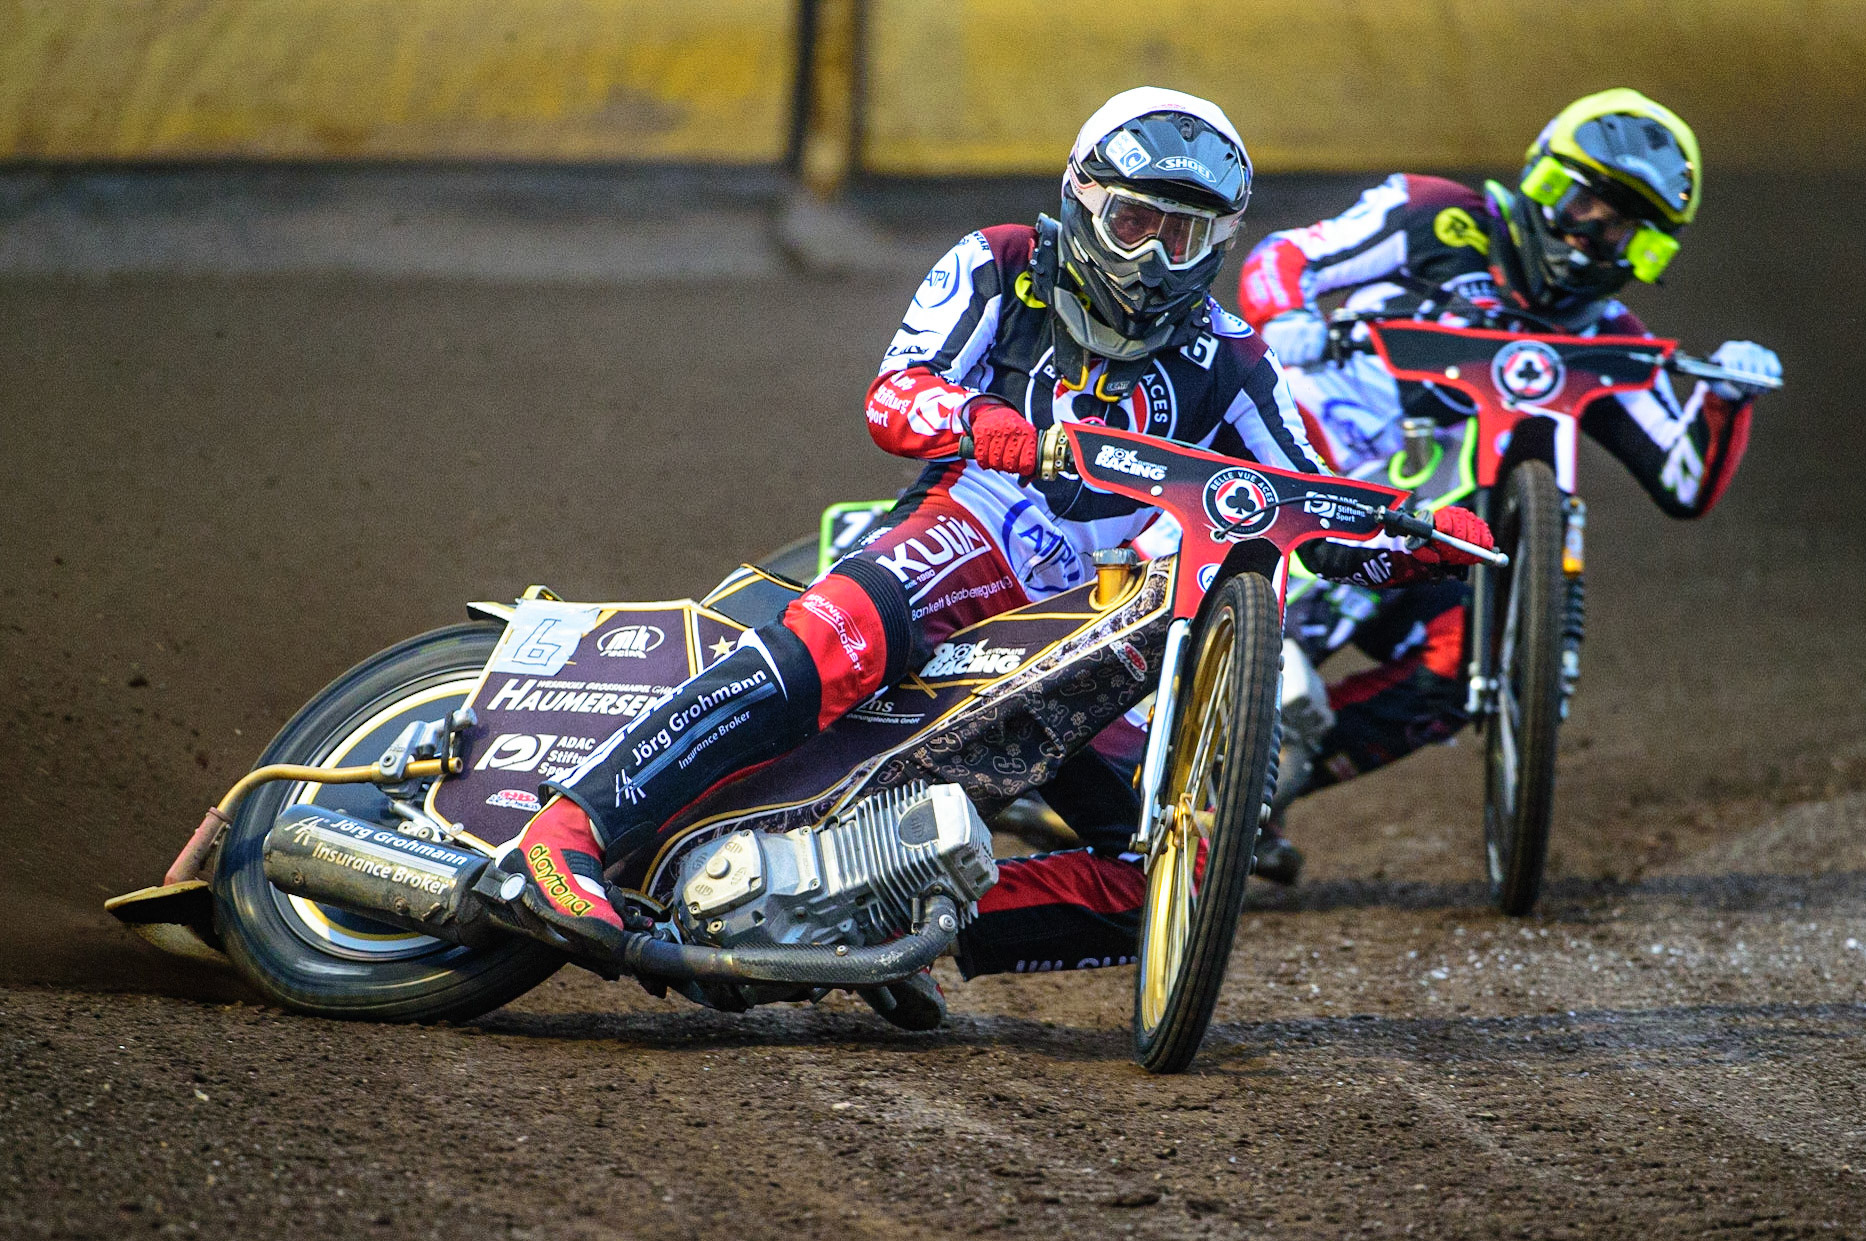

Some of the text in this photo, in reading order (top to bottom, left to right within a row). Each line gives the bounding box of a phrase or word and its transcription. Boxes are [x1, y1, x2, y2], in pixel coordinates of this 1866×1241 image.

[1165, 157, 1212, 180] SHOEI
[1143, 373, 1169, 424] ACES
[866, 400, 889, 428] Sport
[1094, 453, 1166, 481] RACING
[1209, 471, 1275, 503] BELLE VUE ACES
[1336, 512, 1356, 523] Sport
[1337, 505, 1366, 518] Stiftung
[511, 617, 562, 667] 6
[919, 653, 1021, 677] RACING
[631, 669, 767, 766] Jörg Grohmann
[556, 735, 596, 751] ADAC
[678, 711, 751, 770] Insurance Broker
[538, 762, 568, 778] Spo
[547, 750, 589, 764] Stiftu
[329, 818, 468, 866] Jörg Grohmann
[312, 841, 456, 897] Insurance Broker
[527, 842, 595, 917] daytona
